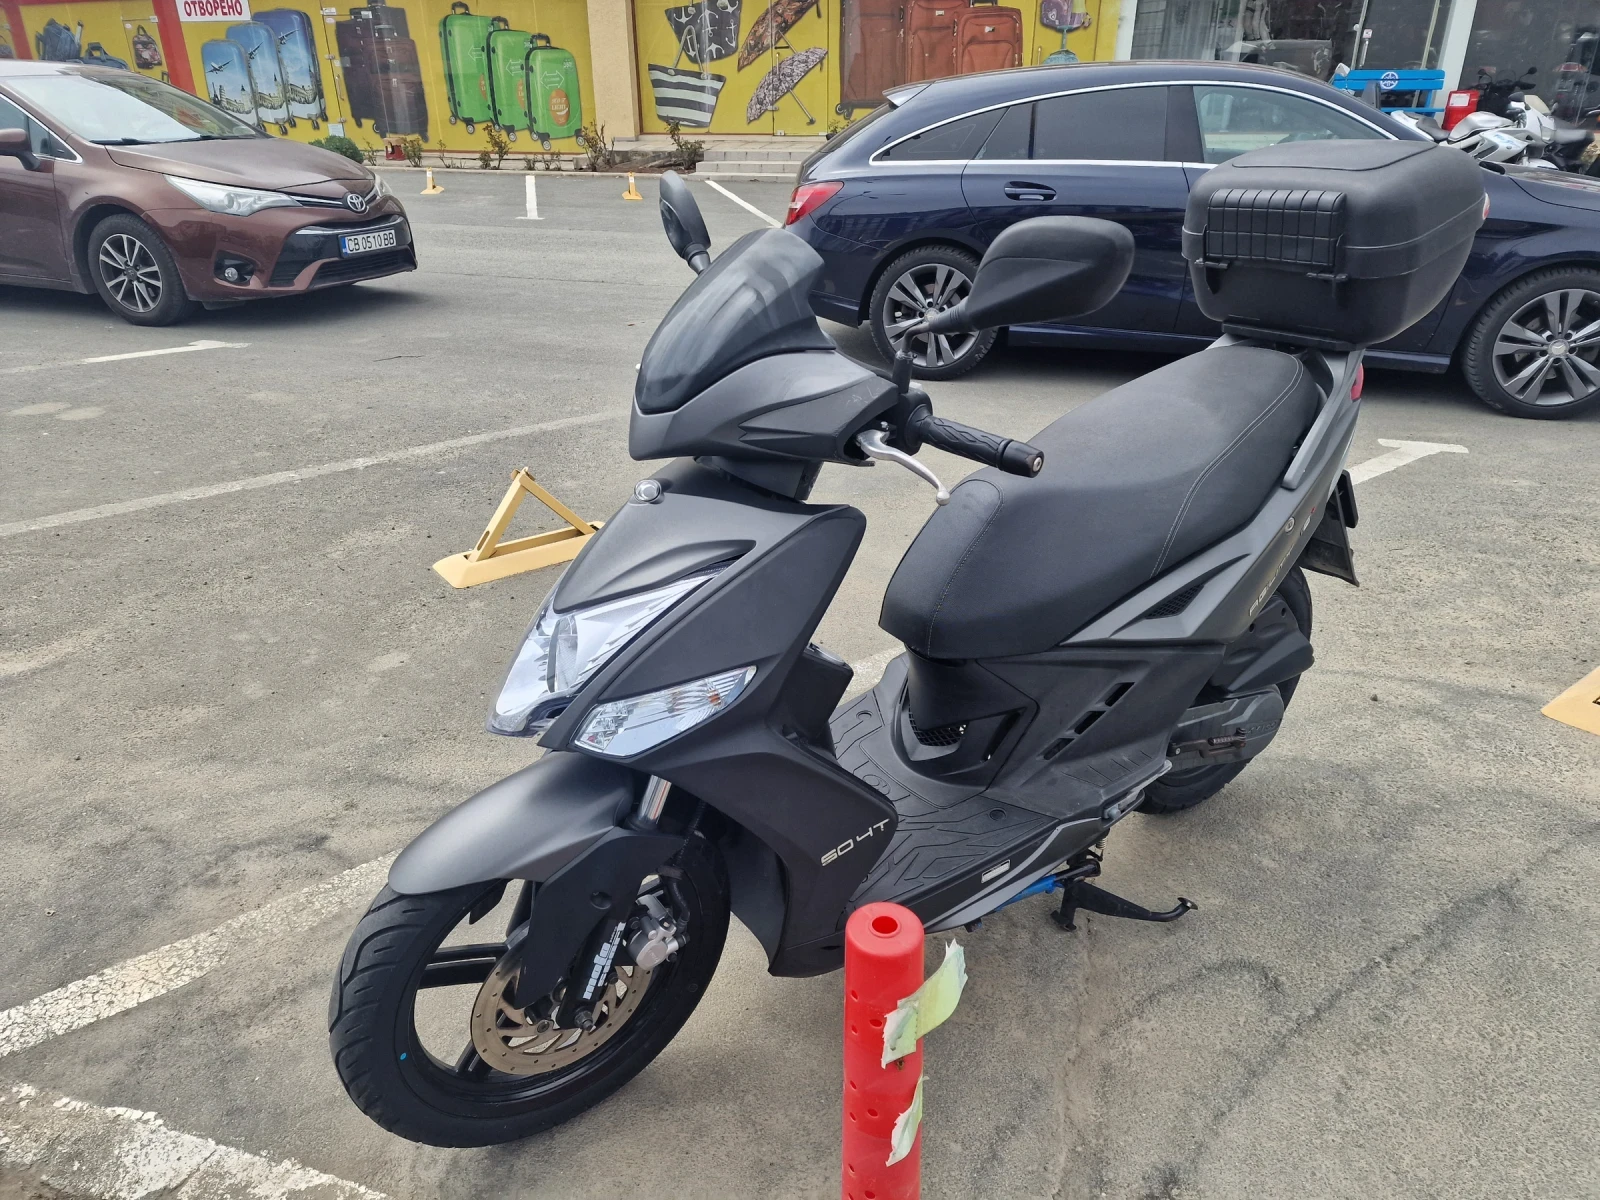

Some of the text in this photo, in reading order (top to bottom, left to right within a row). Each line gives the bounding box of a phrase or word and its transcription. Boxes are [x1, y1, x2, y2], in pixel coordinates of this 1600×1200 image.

[183, 0, 243, 17] ОТВОРЕНО
[347, 232, 395, 252] CB 0510 BB
[821, 818, 890, 867] 50 4T
